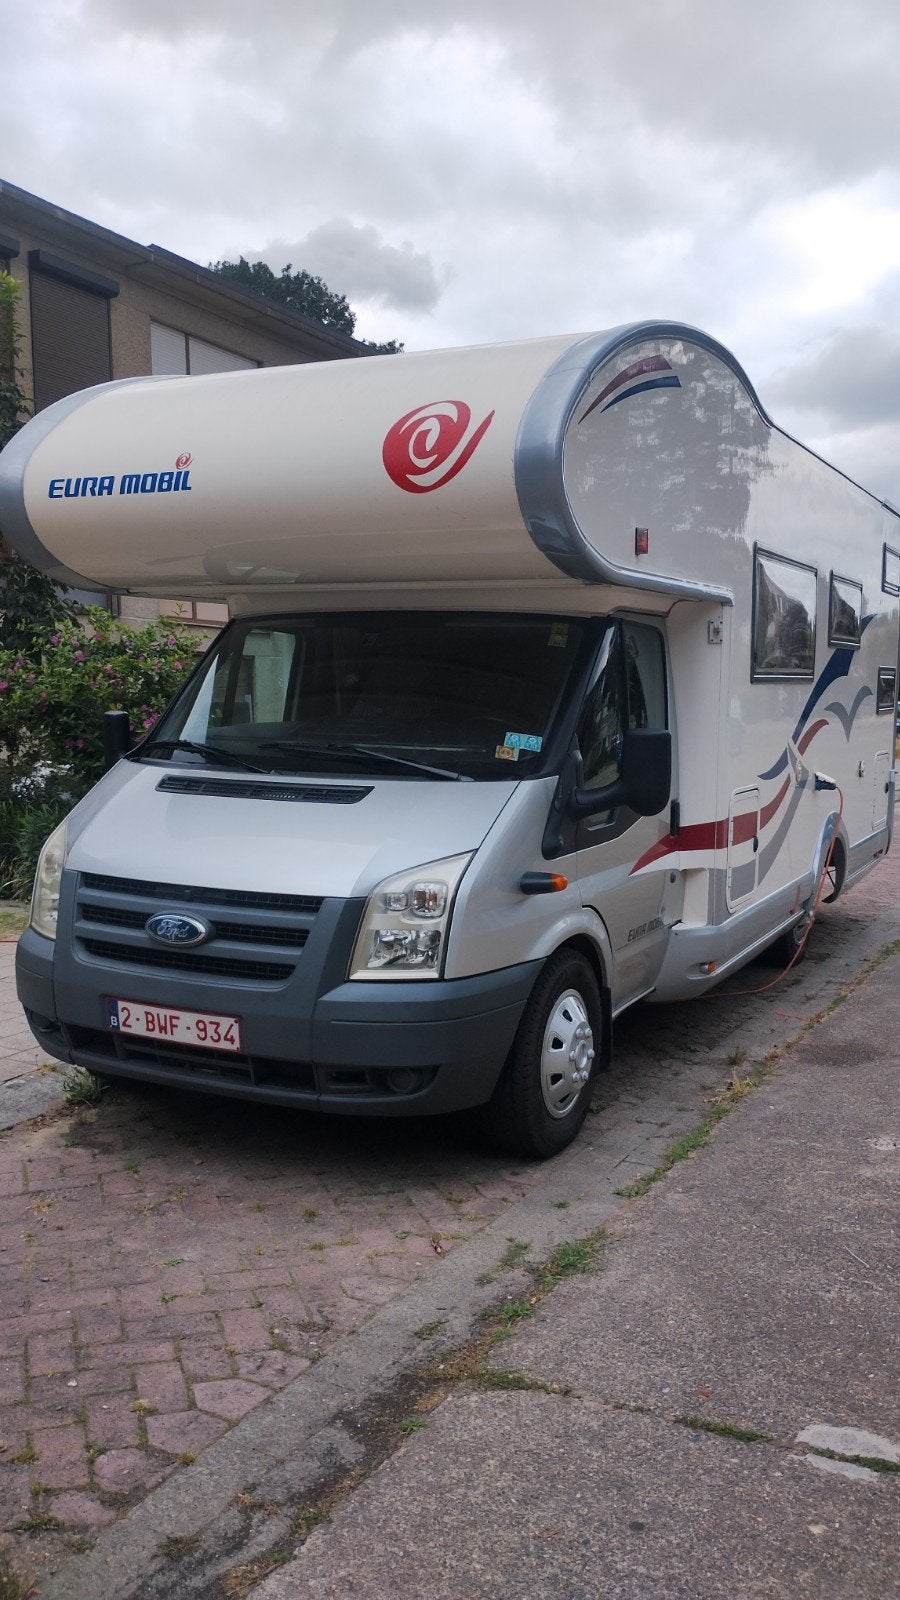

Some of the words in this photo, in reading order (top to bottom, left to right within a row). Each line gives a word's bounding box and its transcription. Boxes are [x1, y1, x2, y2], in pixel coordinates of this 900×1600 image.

[48, 475, 115, 499] EURA
[119, 470, 192, 495] MOBIL
[156, 919, 190, 941] Ford
[110, 1015, 118, 1026] B
